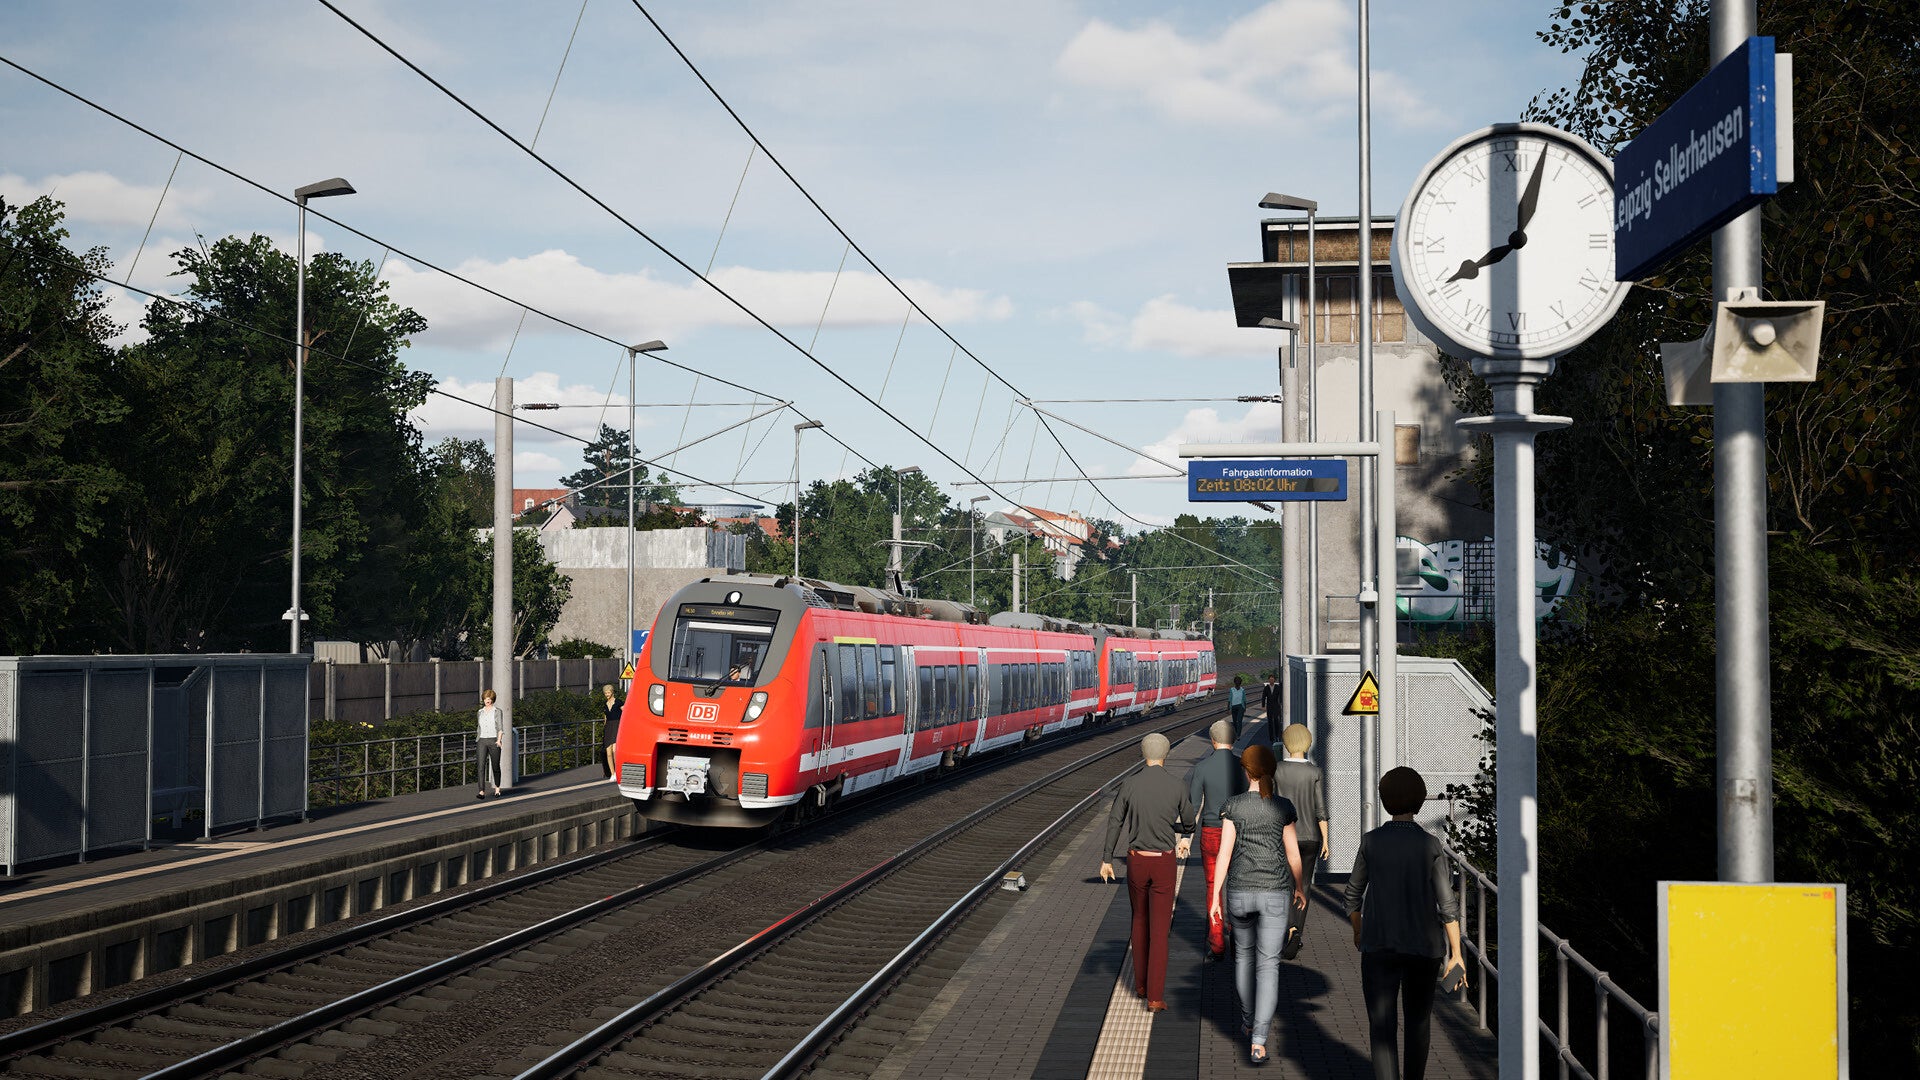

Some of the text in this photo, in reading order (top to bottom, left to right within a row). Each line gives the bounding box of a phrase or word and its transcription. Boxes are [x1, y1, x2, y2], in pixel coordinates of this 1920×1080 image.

[1654, 105, 1743, 201] Sellerhausen
[1504, 154, 1529, 172] XII
[1463, 164, 1486, 187] XI
[1552, 165, 1563, 182] I
[1435, 194, 1456, 213] X
[1577, 193, 1596, 209] II
[1426, 236, 1445, 253] IX
[1589, 234, 1608, 249] III
[1578, 268, 1600, 292] IV
[1464, 298, 1491, 325] VII
[1549, 300, 1564, 319] V
[1507, 312, 1527, 331] VI
[1222, 468, 1312, 479] Fahrgastinformation
[1197, 479, 1298, 492] Zeit: 08:02 Uhr
[690, 705, 717, 720] DB
